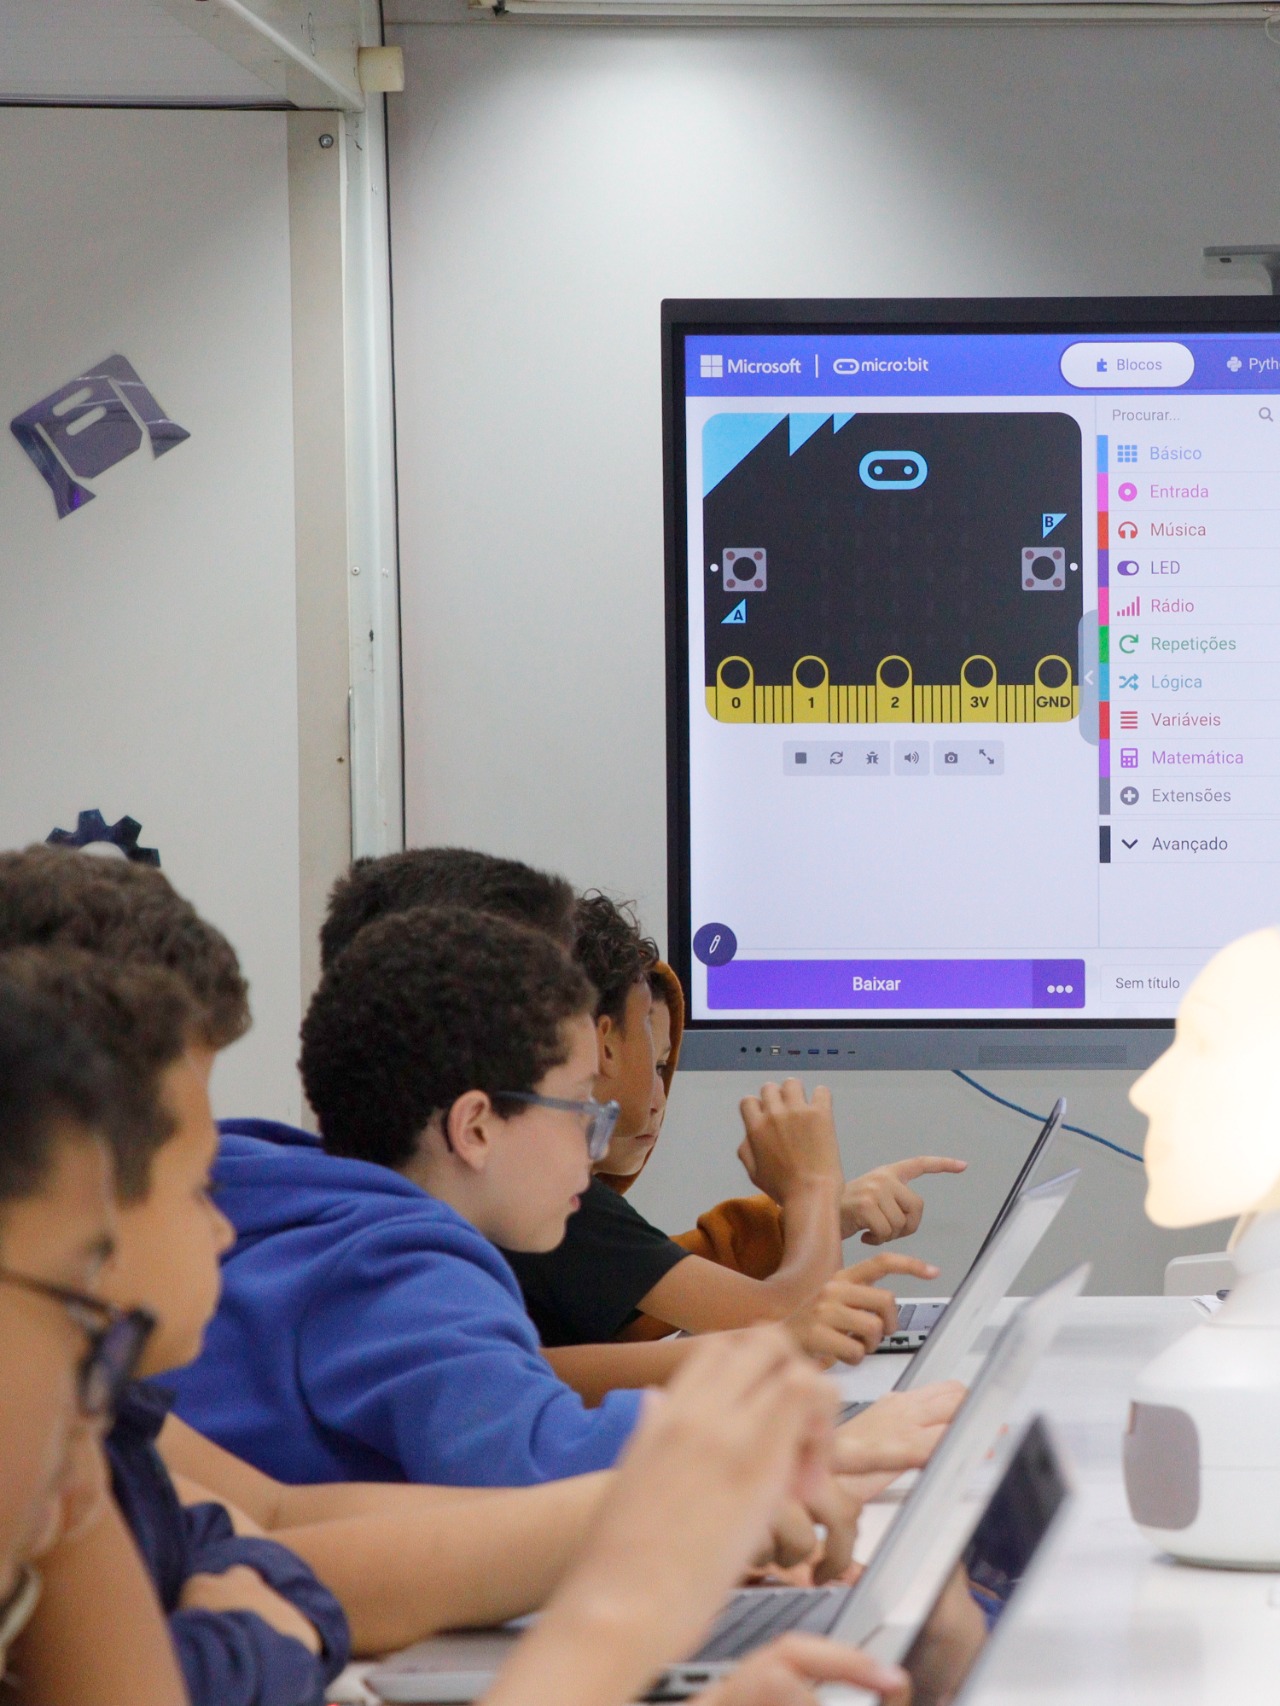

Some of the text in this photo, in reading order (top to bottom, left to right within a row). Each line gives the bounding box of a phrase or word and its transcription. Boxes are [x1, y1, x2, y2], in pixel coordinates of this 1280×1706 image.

[727, 357, 802, 374] Microsoft
[861, 357, 929, 372] micro:bit
[1116, 358, 1163, 371] Blocos
[1112, 408, 1181, 424] Procurar...
[1150, 445, 1202, 460] Básico
[1150, 483, 1209, 499] Entrada
[1044, 515, 1054, 528] B
[1150, 521, 1207, 537] Música
[1150, 561, 1181, 575] LED
[1151, 597, 1195, 613] Rádio
[733, 609, 744, 621] A
[1151, 636, 1237, 654] Repetições
[1151, 673, 1203, 692] Lógica
[731, 696, 741, 709] 0
[808, 696, 815, 709] 1
[890, 696, 900, 709] 2
[970, 695, 989, 709] 3V
[1036, 695, 1071, 708] GND
[1151, 711, 1222, 728] Variáveis
[1151, 750, 1244, 765] Matemática
[1151, 788, 1232, 803] Extensões
[1151, 837, 1229, 854] Avançado
[852, 976, 902, 992] Baixar
[1115, 975, 1181, 989] Sem título
